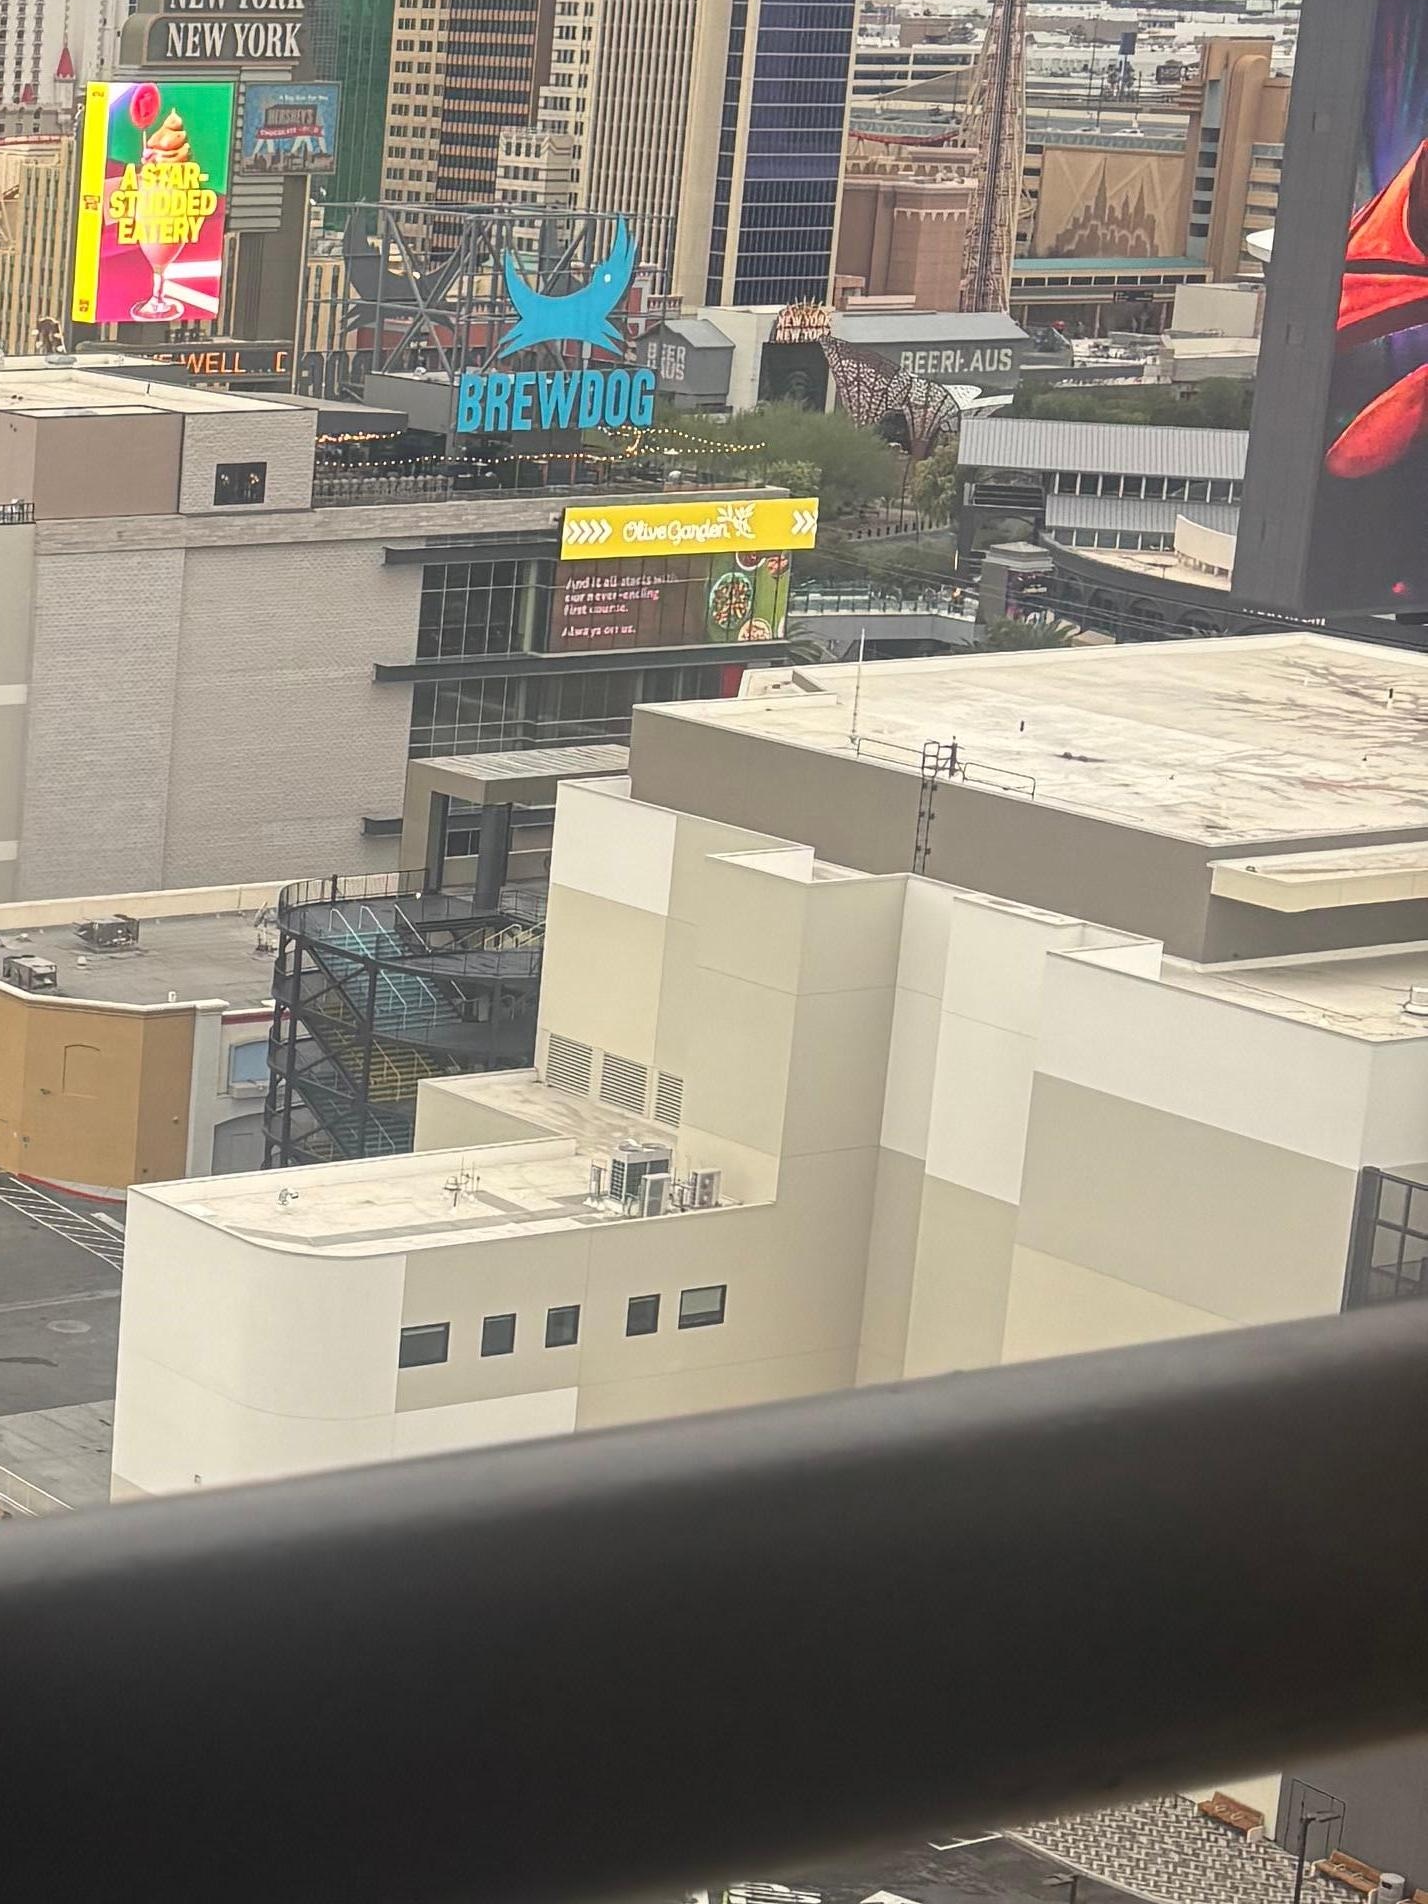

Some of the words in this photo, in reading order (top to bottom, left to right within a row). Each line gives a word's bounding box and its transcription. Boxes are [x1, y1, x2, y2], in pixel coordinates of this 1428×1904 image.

[166, 22, 227, 57] NEW
[234, 22, 303, 57] YORK
[120, 163, 138, 191] A
[141, 162, 209, 191] STAR-
[109, 189, 218, 219] STUDDED
[117, 216, 205, 245] EATERY
[457, 368, 657, 432] BREWDOG
[623, 519, 667, 542] Olive
[667, 519, 732, 546] Garden
[565, 575, 591, 591] And
[603, 575, 618, 588] all
[564, 604, 587, 616] first
